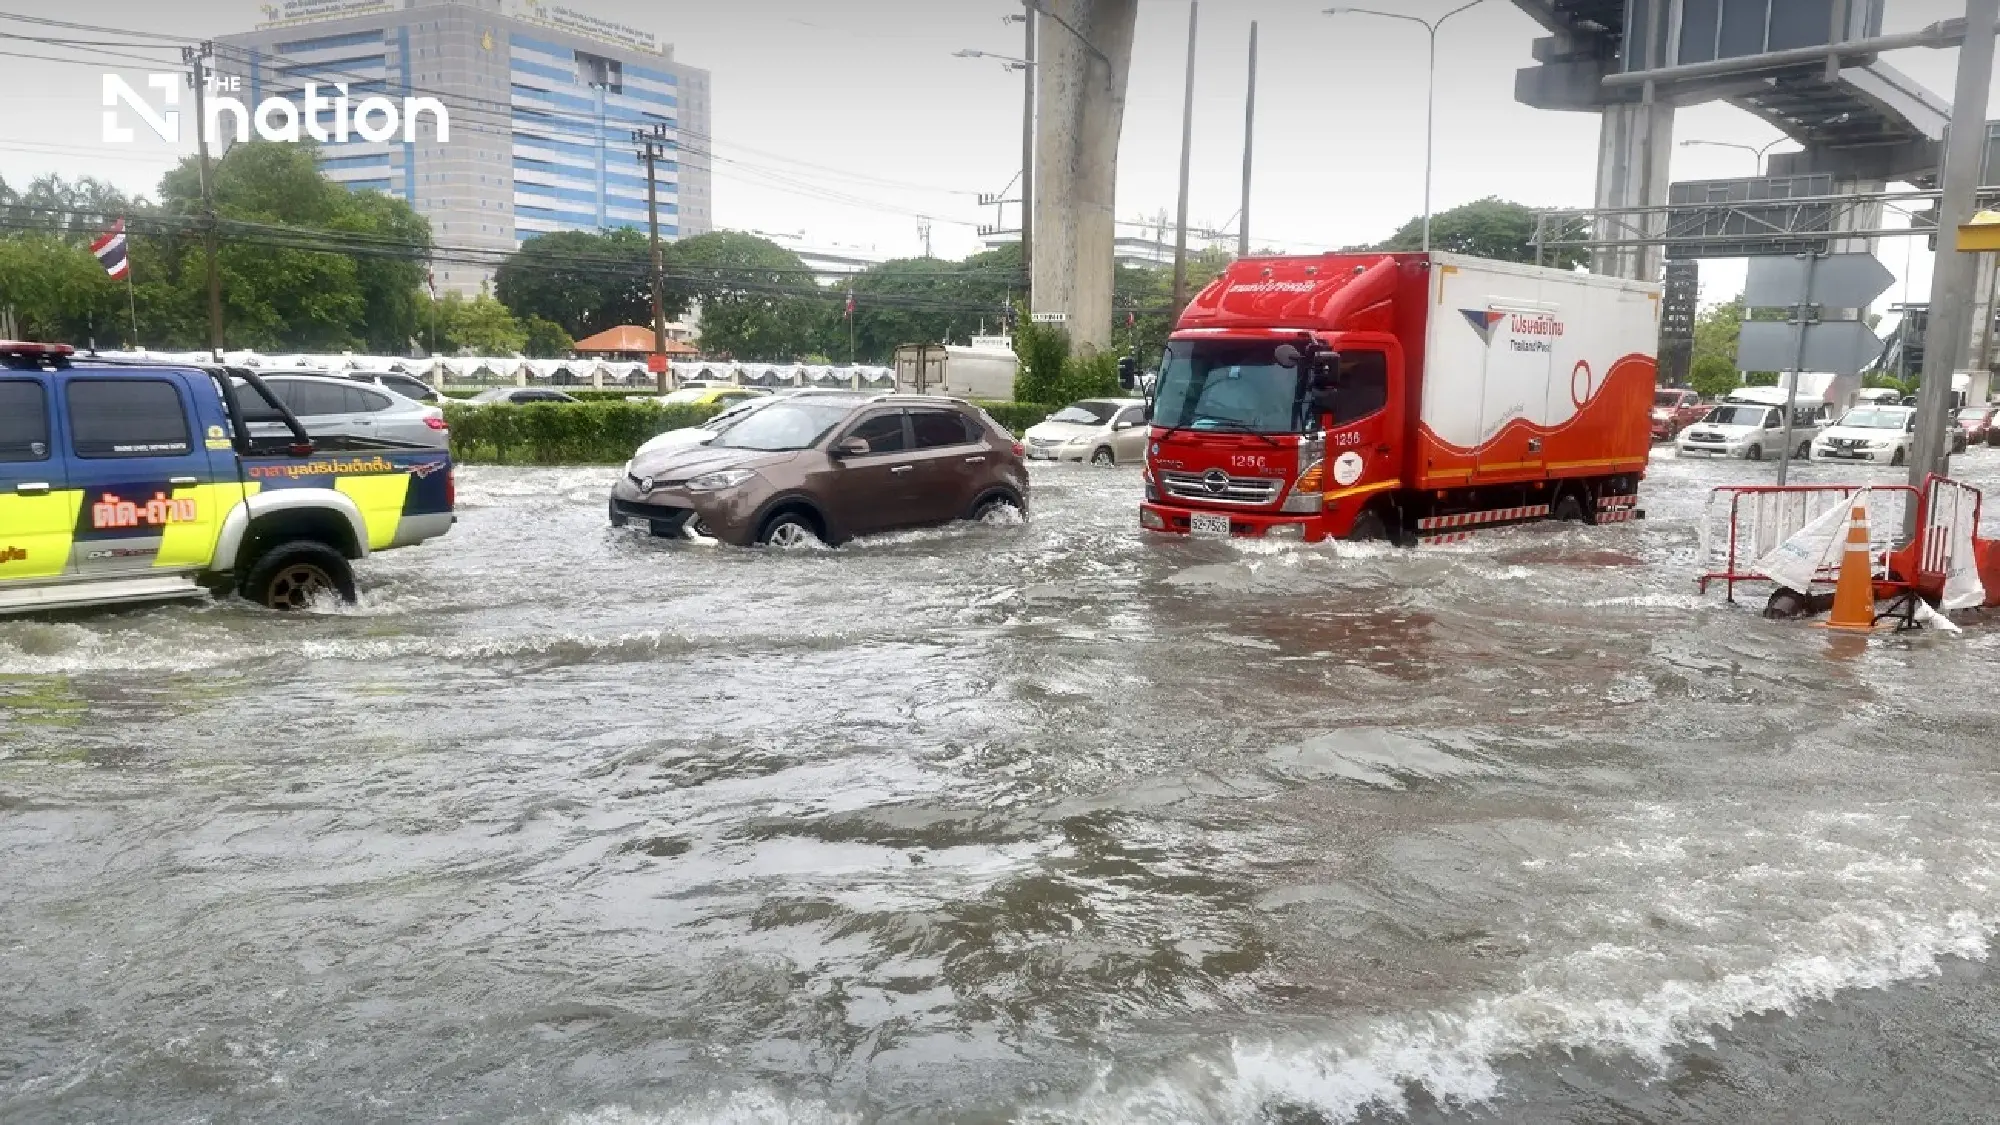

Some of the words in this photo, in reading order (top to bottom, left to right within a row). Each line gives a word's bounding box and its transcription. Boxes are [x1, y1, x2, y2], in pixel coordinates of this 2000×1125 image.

[1334, 431, 1361, 446] 1256
[1230, 454, 1267, 468] 1256
[92, 491, 198, 529] ตัด-ถ่าง
